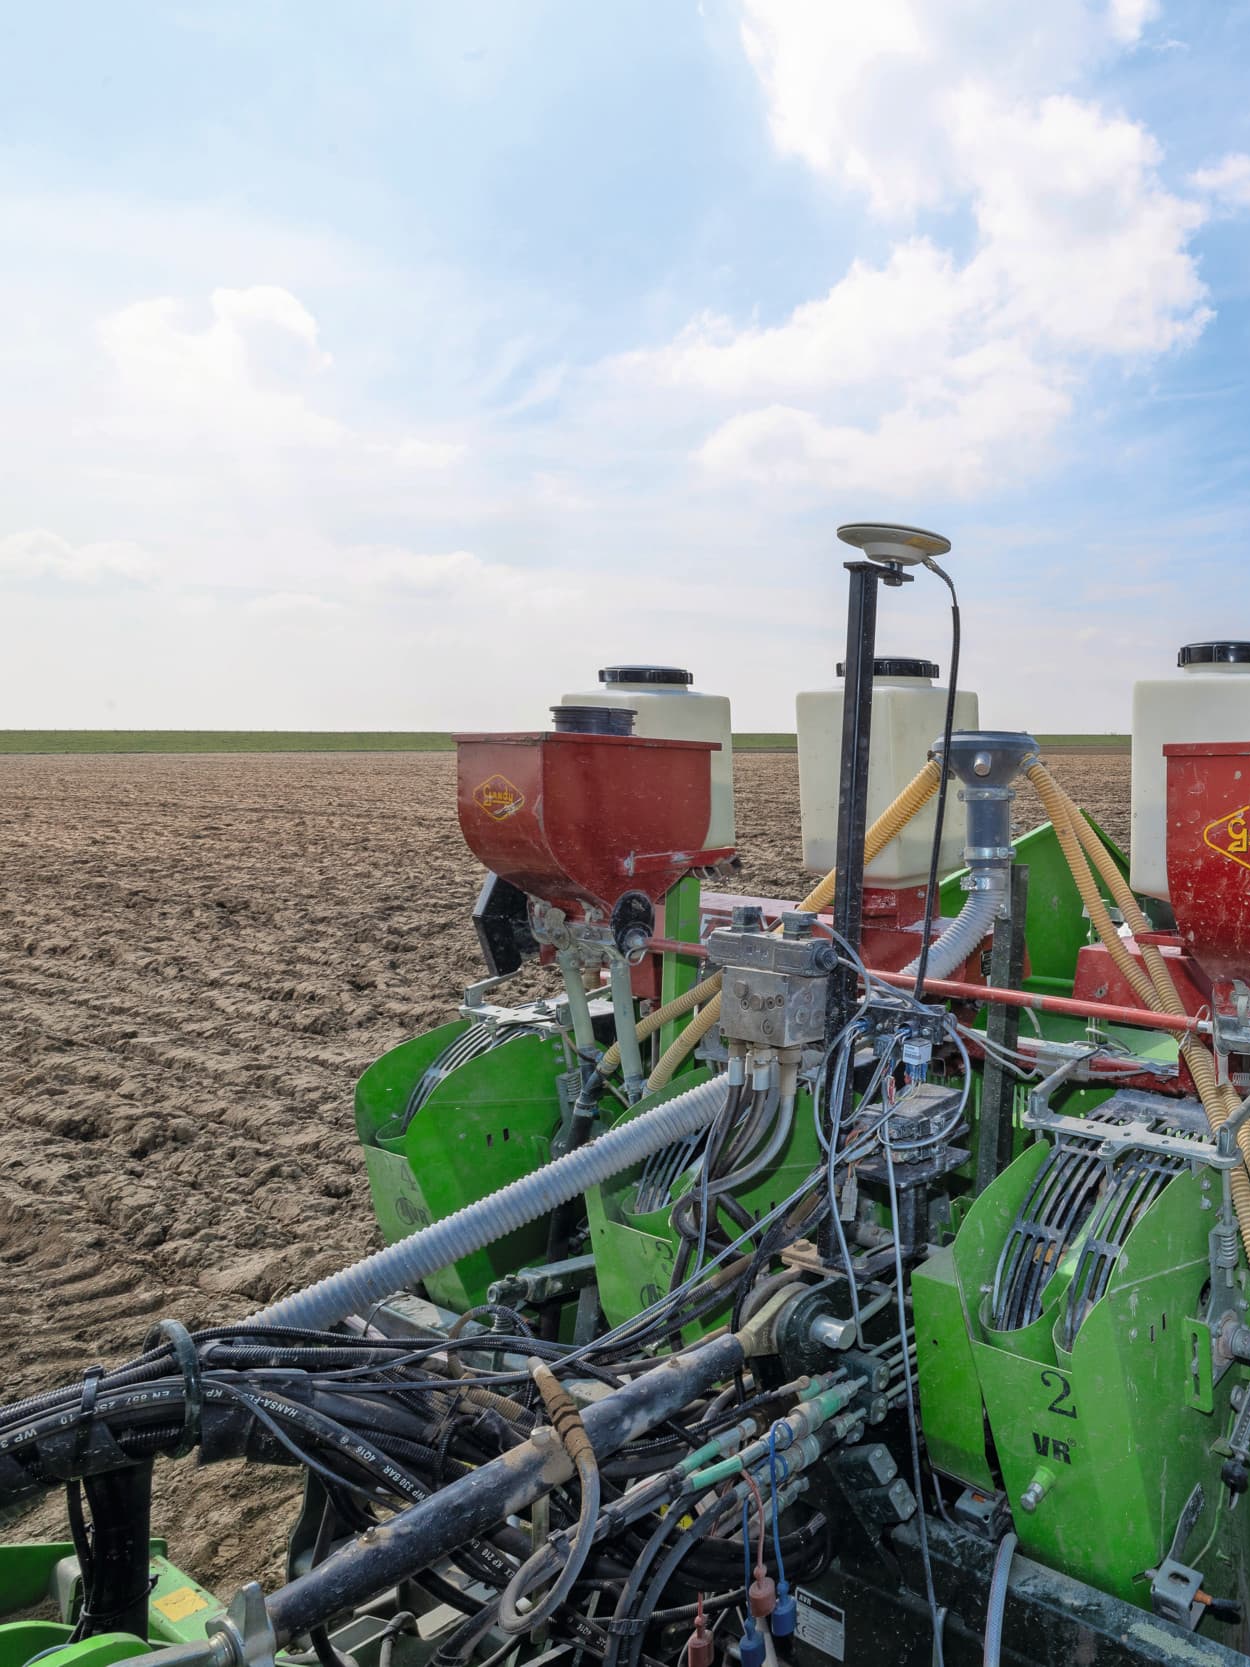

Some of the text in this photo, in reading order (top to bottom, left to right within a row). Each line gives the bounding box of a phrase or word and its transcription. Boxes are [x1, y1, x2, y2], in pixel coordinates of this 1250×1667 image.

[1041, 1370, 1077, 1419] 2
[13, 1427, 38, 1444] WP
[383, 1465, 402, 1482] BAR
